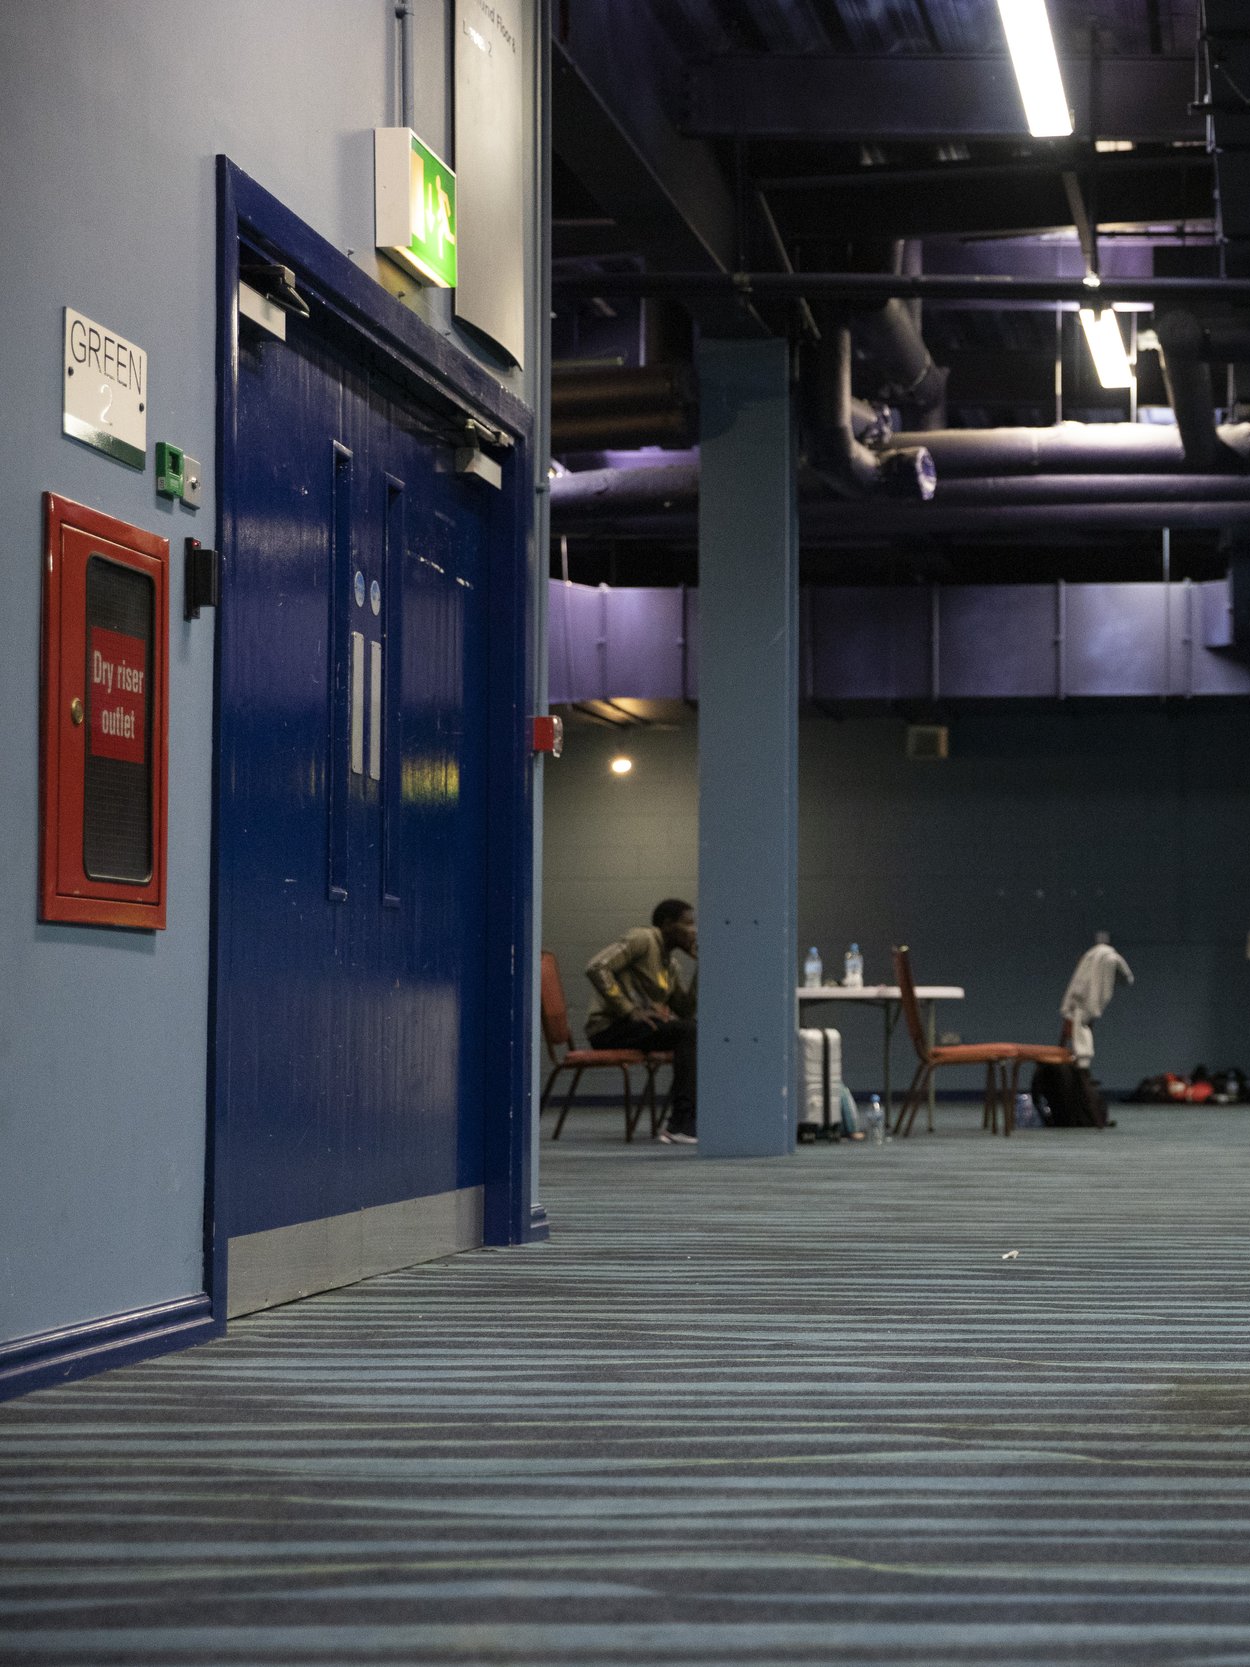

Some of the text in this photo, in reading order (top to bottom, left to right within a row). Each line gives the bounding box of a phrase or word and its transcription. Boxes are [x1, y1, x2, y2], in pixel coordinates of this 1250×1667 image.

[70, 319, 142, 395] GREEN
[100, 383, 114, 426] 2
[94, 650, 144, 693] Dry riser
[102, 706, 135, 739] outlet
